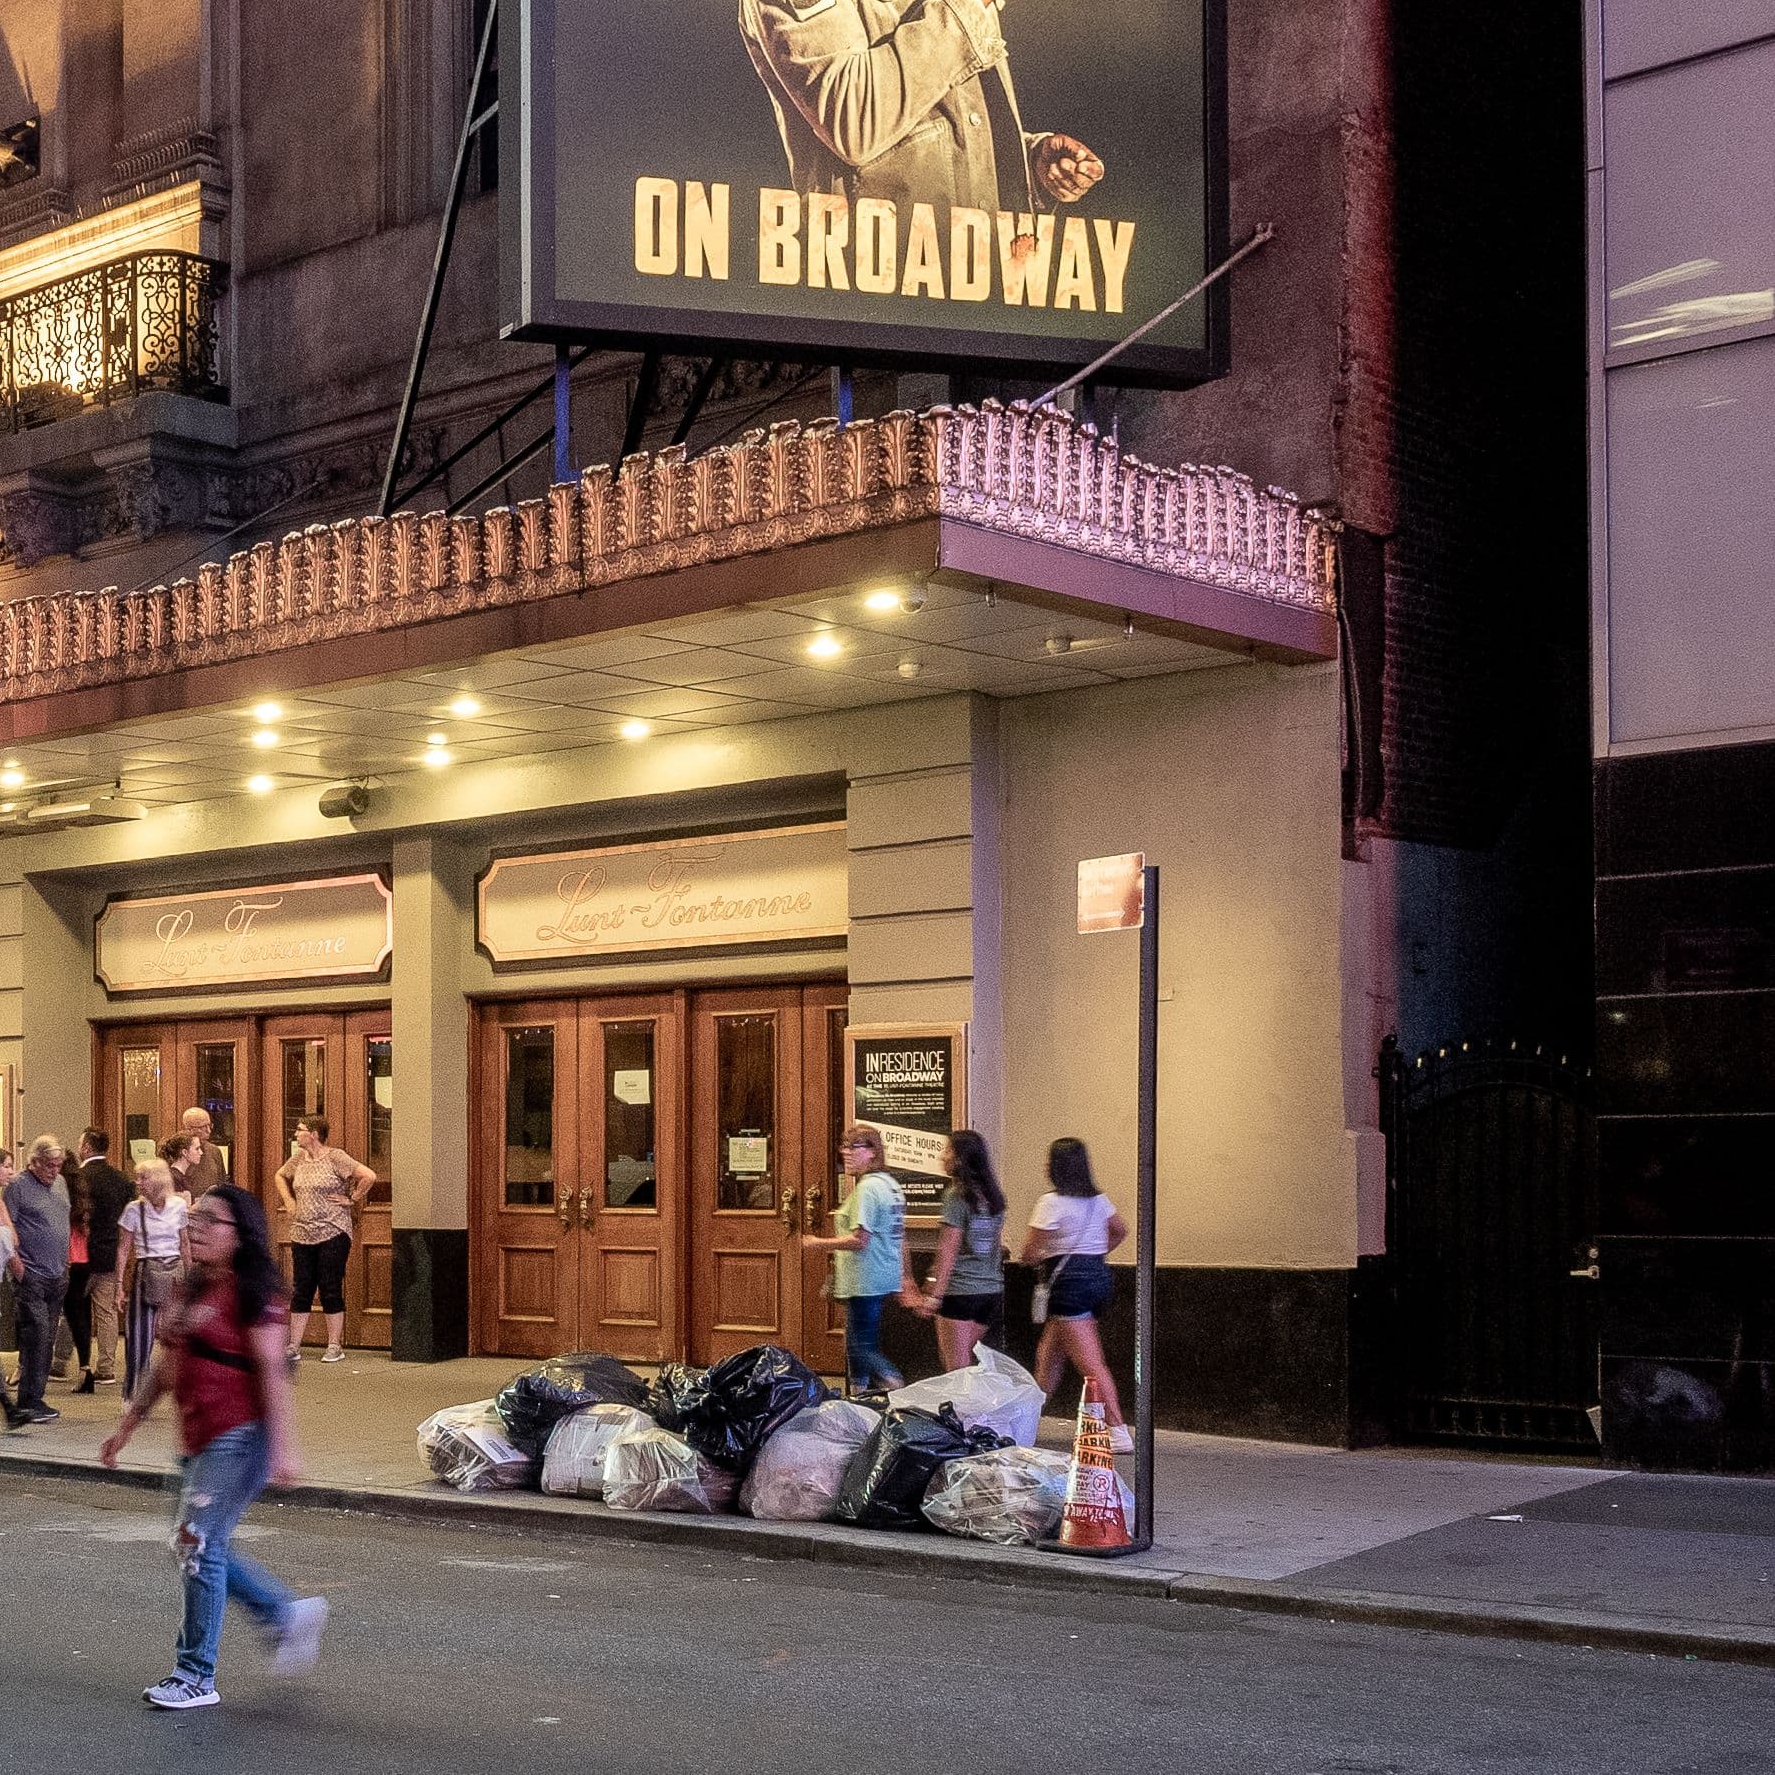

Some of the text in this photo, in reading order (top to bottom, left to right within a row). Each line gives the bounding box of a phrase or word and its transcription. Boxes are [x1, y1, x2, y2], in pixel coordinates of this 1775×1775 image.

[634, 175, 1137, 314] ON BROADWAY
[885, 1131, 945, 1153] OFFICE HOURS:
